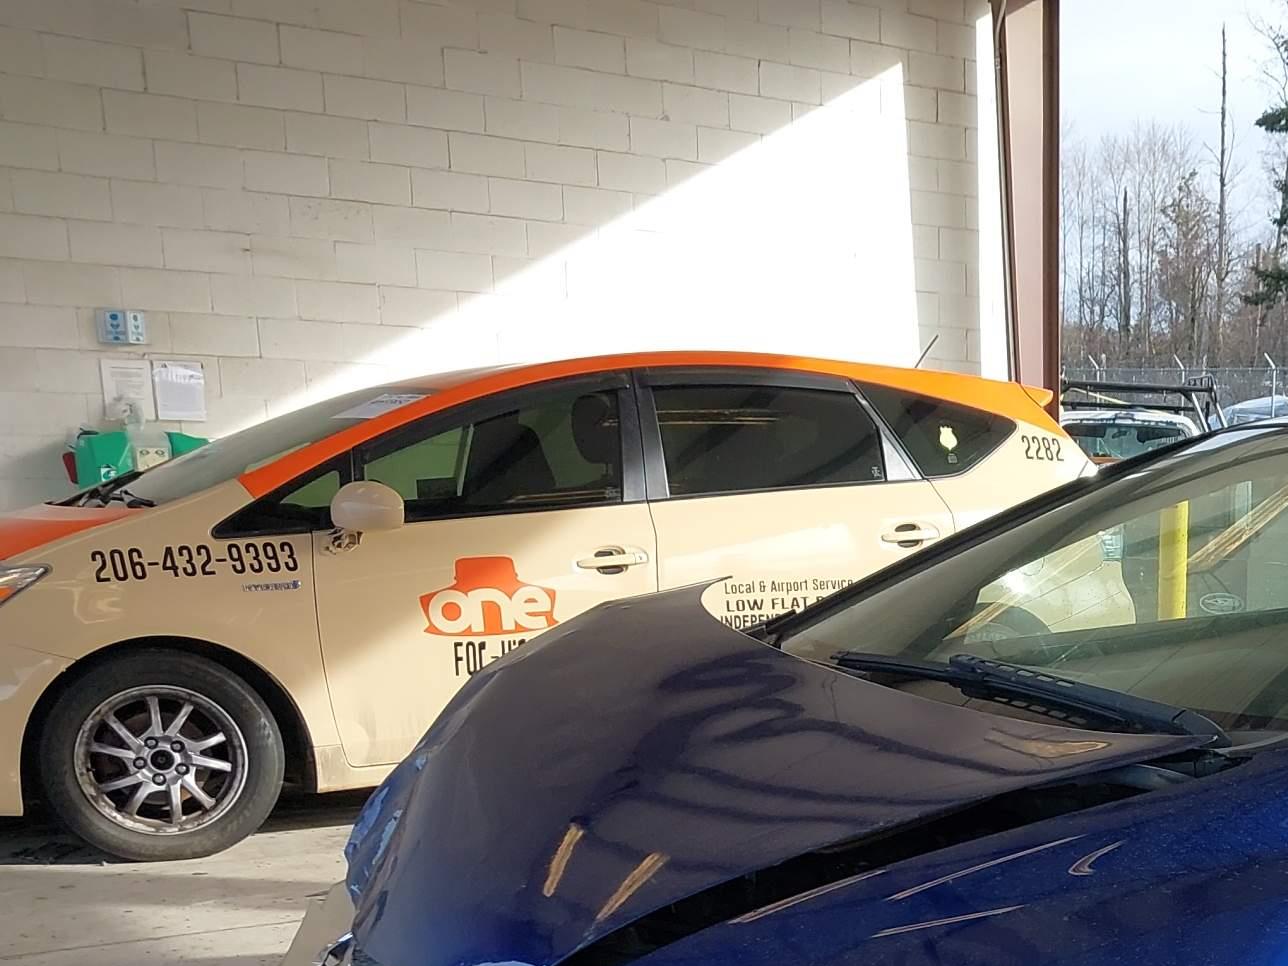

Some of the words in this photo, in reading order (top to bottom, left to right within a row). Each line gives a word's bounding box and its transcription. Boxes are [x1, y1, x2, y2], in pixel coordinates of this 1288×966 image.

[1021, 434, 1065, 462] 2282
[91, 541, 298, 583] 206-432-9393
[724, 580, 756, 595] Local
[759, 580, 767, 593] &
[770, 579, 808, 596] Airport
[428, 585, 553, 634] one
[726, 598, 764, 613] LOW
[771, 596, 809, 610] FLAT
